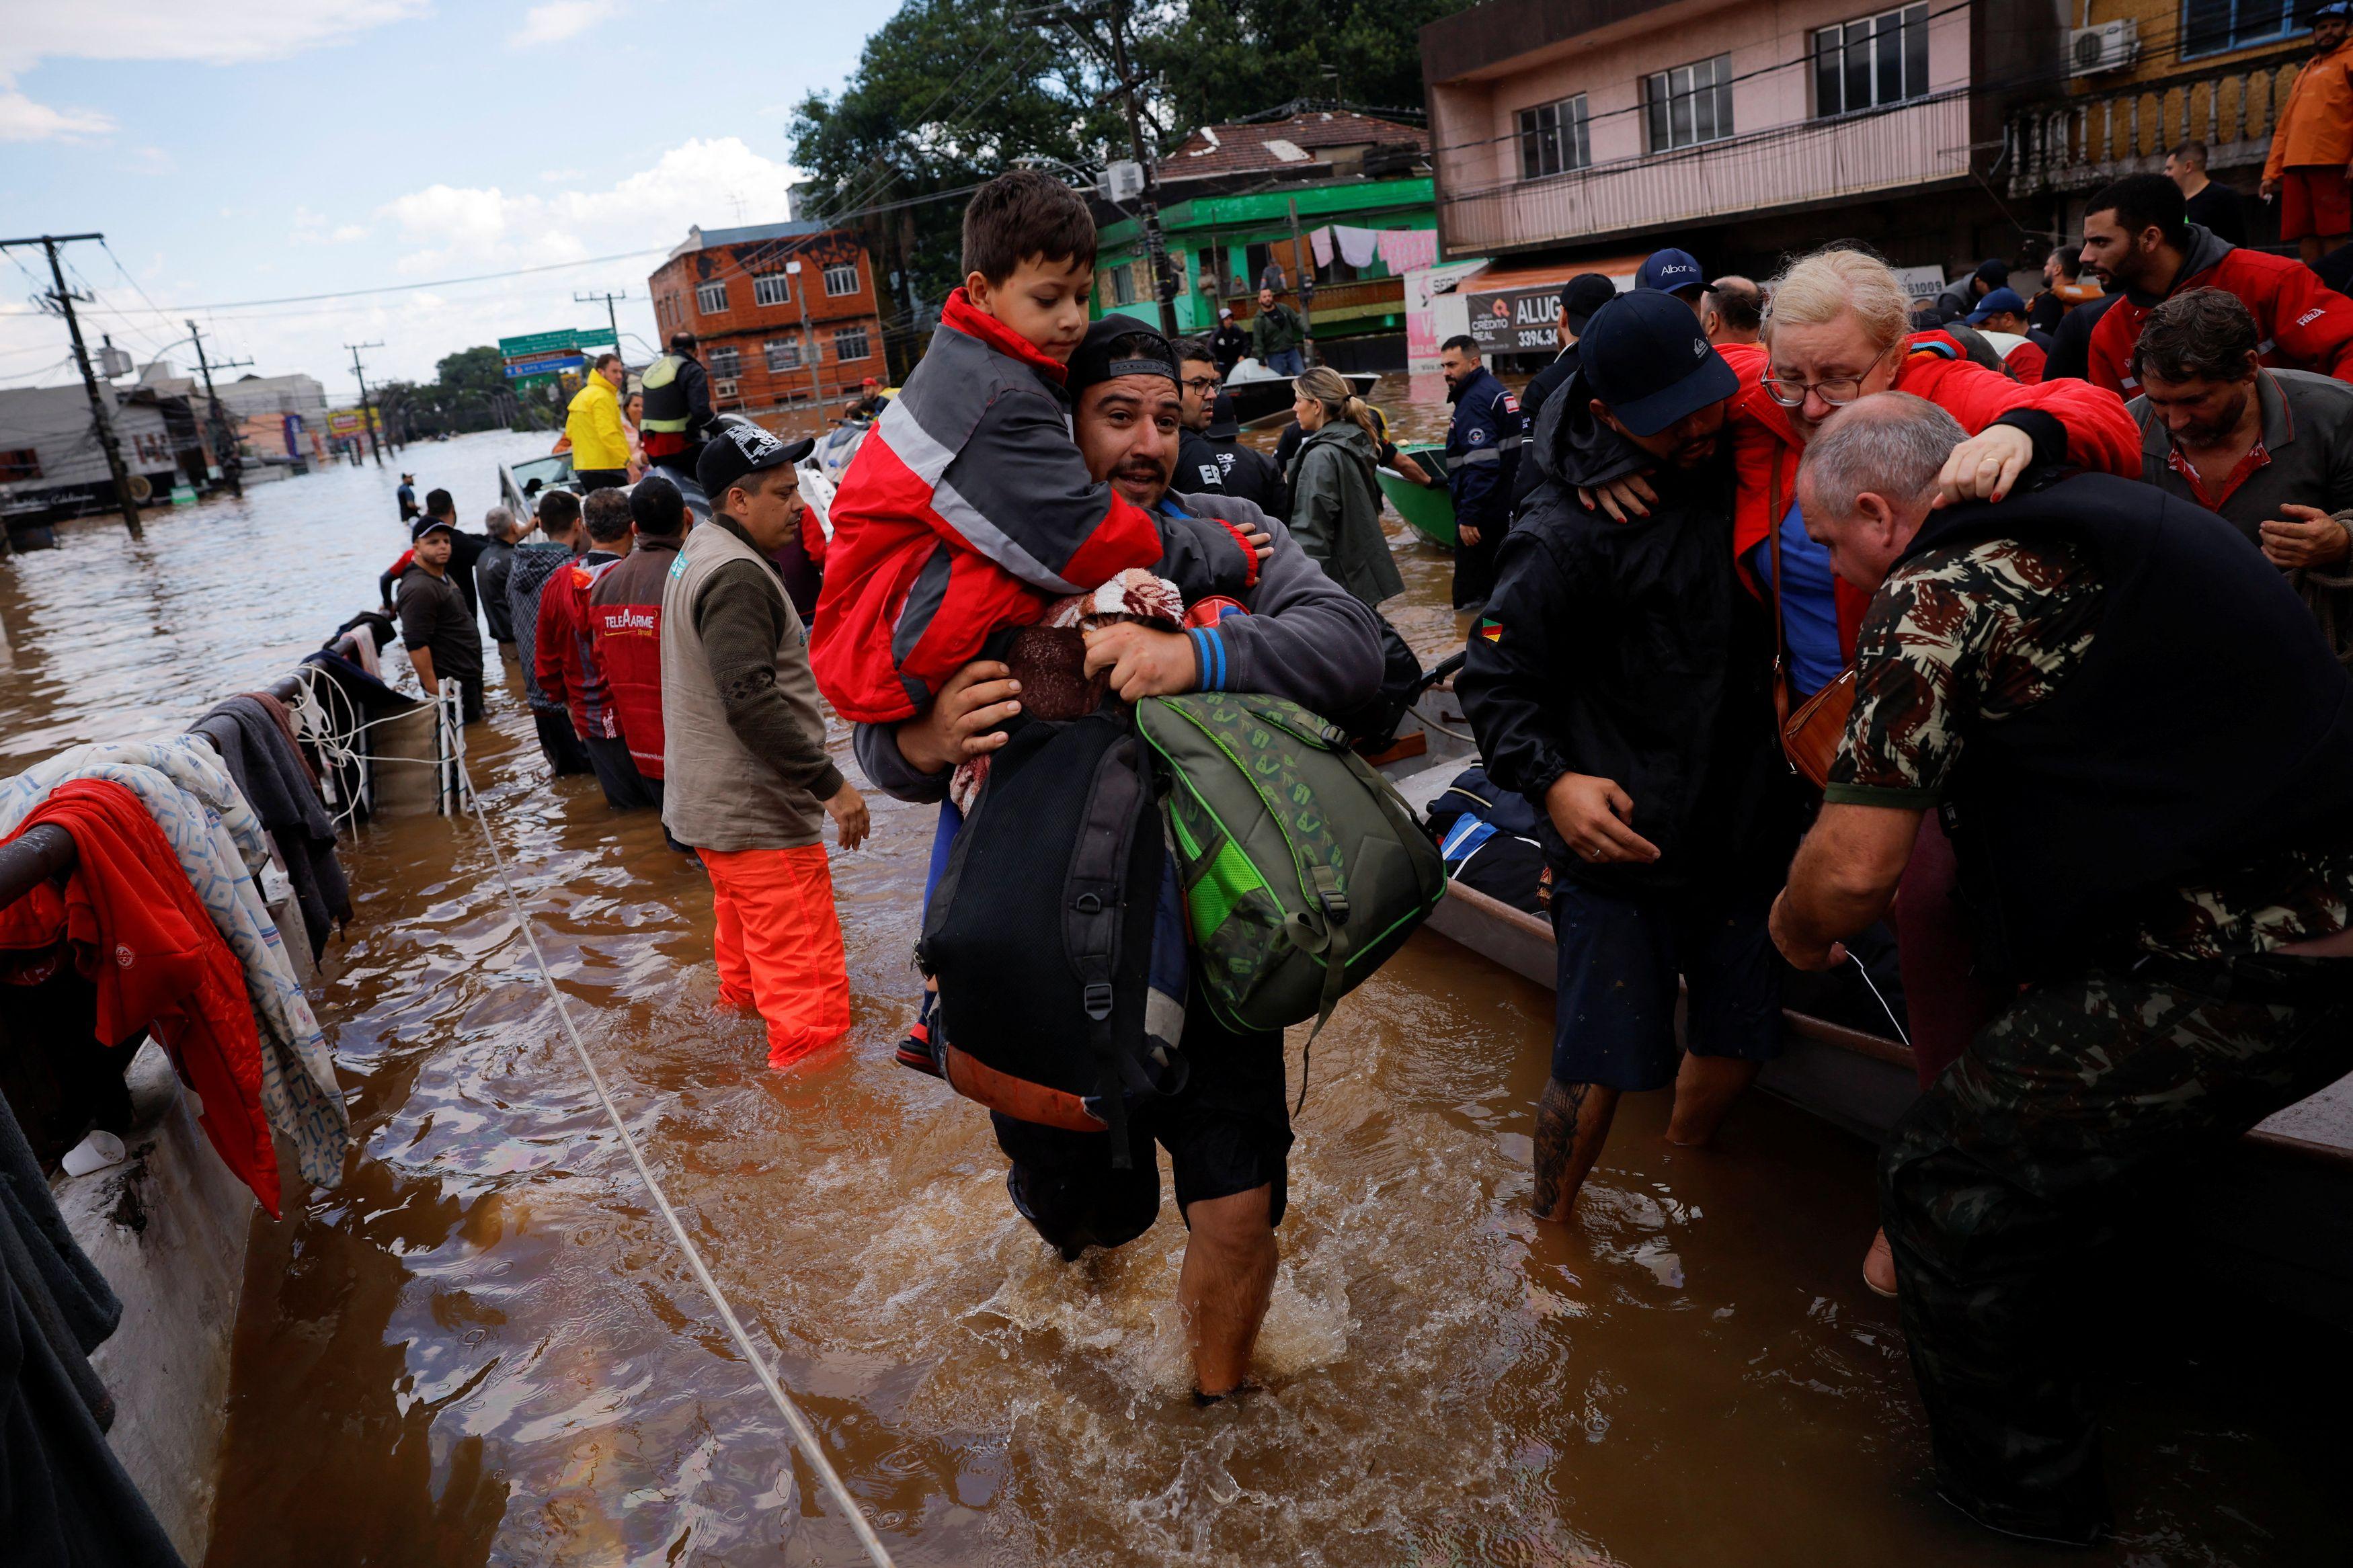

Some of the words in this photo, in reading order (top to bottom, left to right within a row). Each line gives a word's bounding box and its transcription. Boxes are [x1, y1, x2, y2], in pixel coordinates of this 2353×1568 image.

[1661, 264, 1686, 276] Albor
[1516, 295, 1561, 325] ALUG
[1472, 318, 1508, 331] CRÉDITO
[1472, 330, 1495, 341] REAL
[1198, 464, 1222, 485] EB
